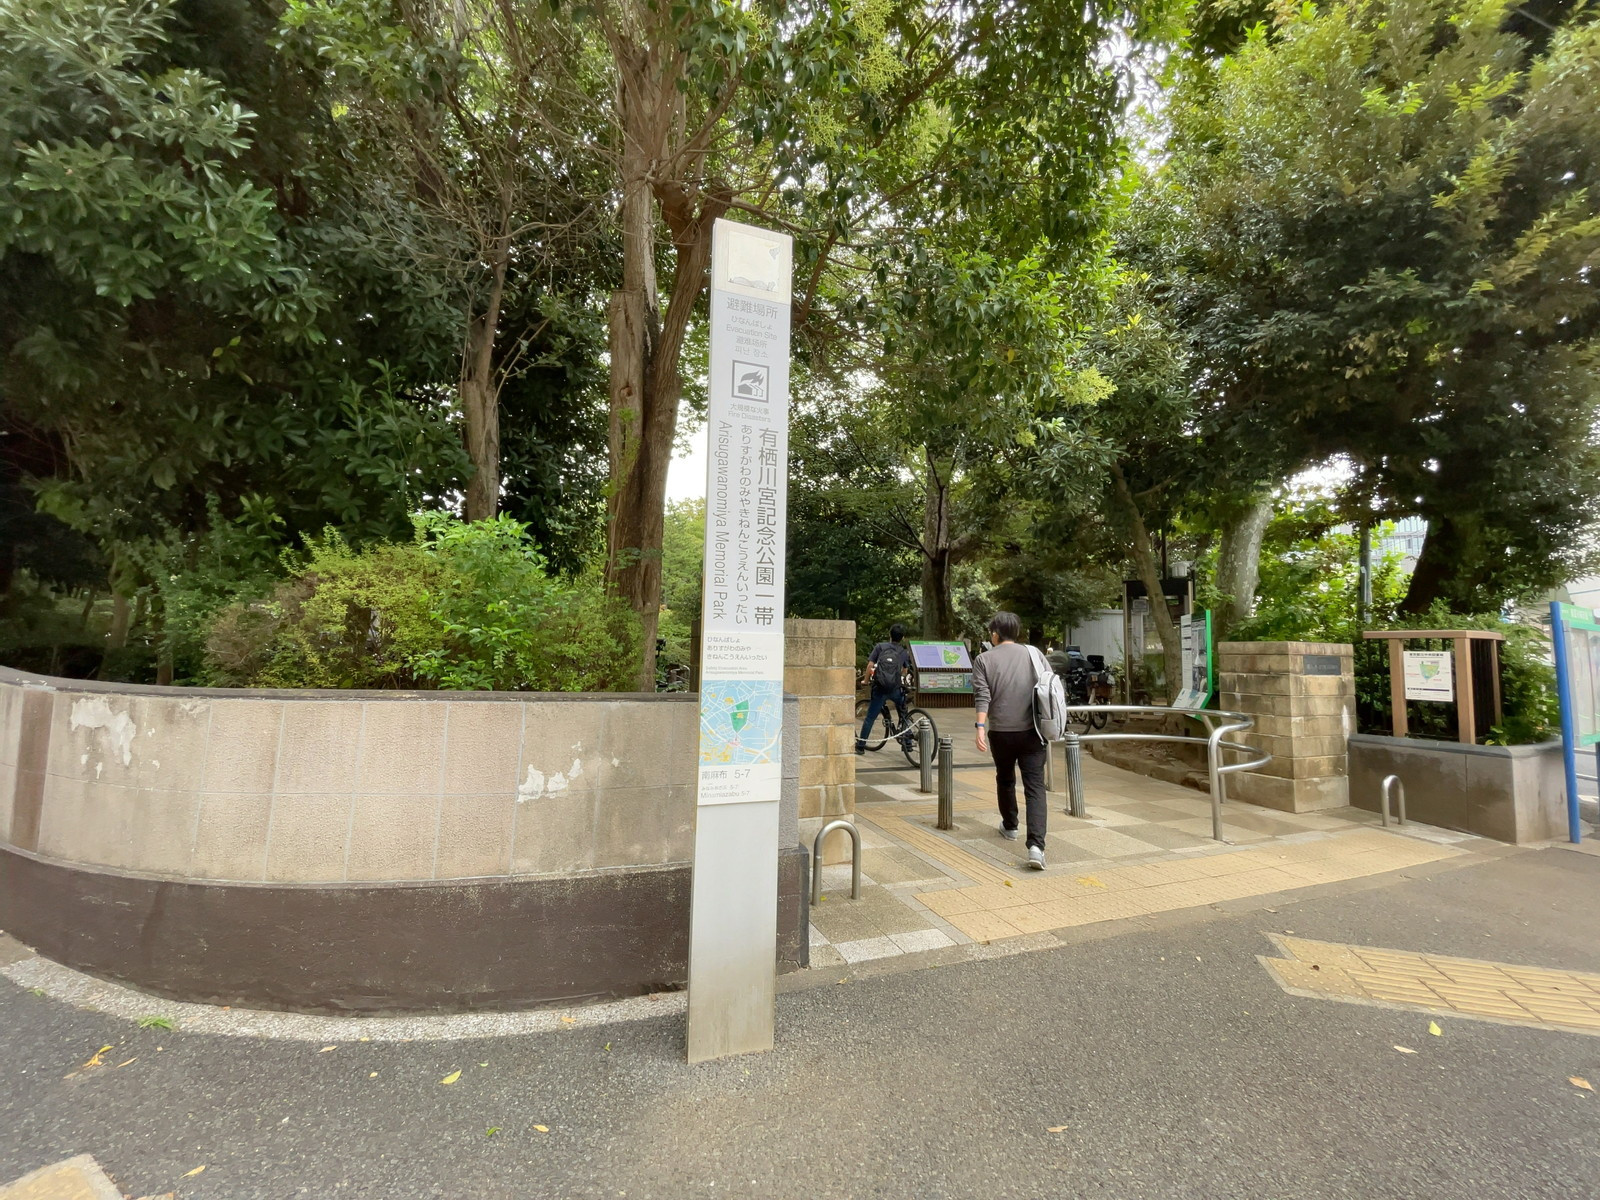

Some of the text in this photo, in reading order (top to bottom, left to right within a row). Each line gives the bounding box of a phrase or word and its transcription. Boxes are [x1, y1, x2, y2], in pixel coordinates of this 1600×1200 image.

[727, 297, 778, 319] 避難場所
[726, 324, 778, 341] Evacuation Site
[731, 315, 773, 330] ひなんばしょ
[713, 420, 732, 620] Arisugawanomiya Memorial Park
[735, 424, 753, 625] ありすがわのみやきねんこうえんいったい
[754, 427, 779, 626] 有栖川宮記念公園一帯
[734, 768, 751, 779] 5-7
